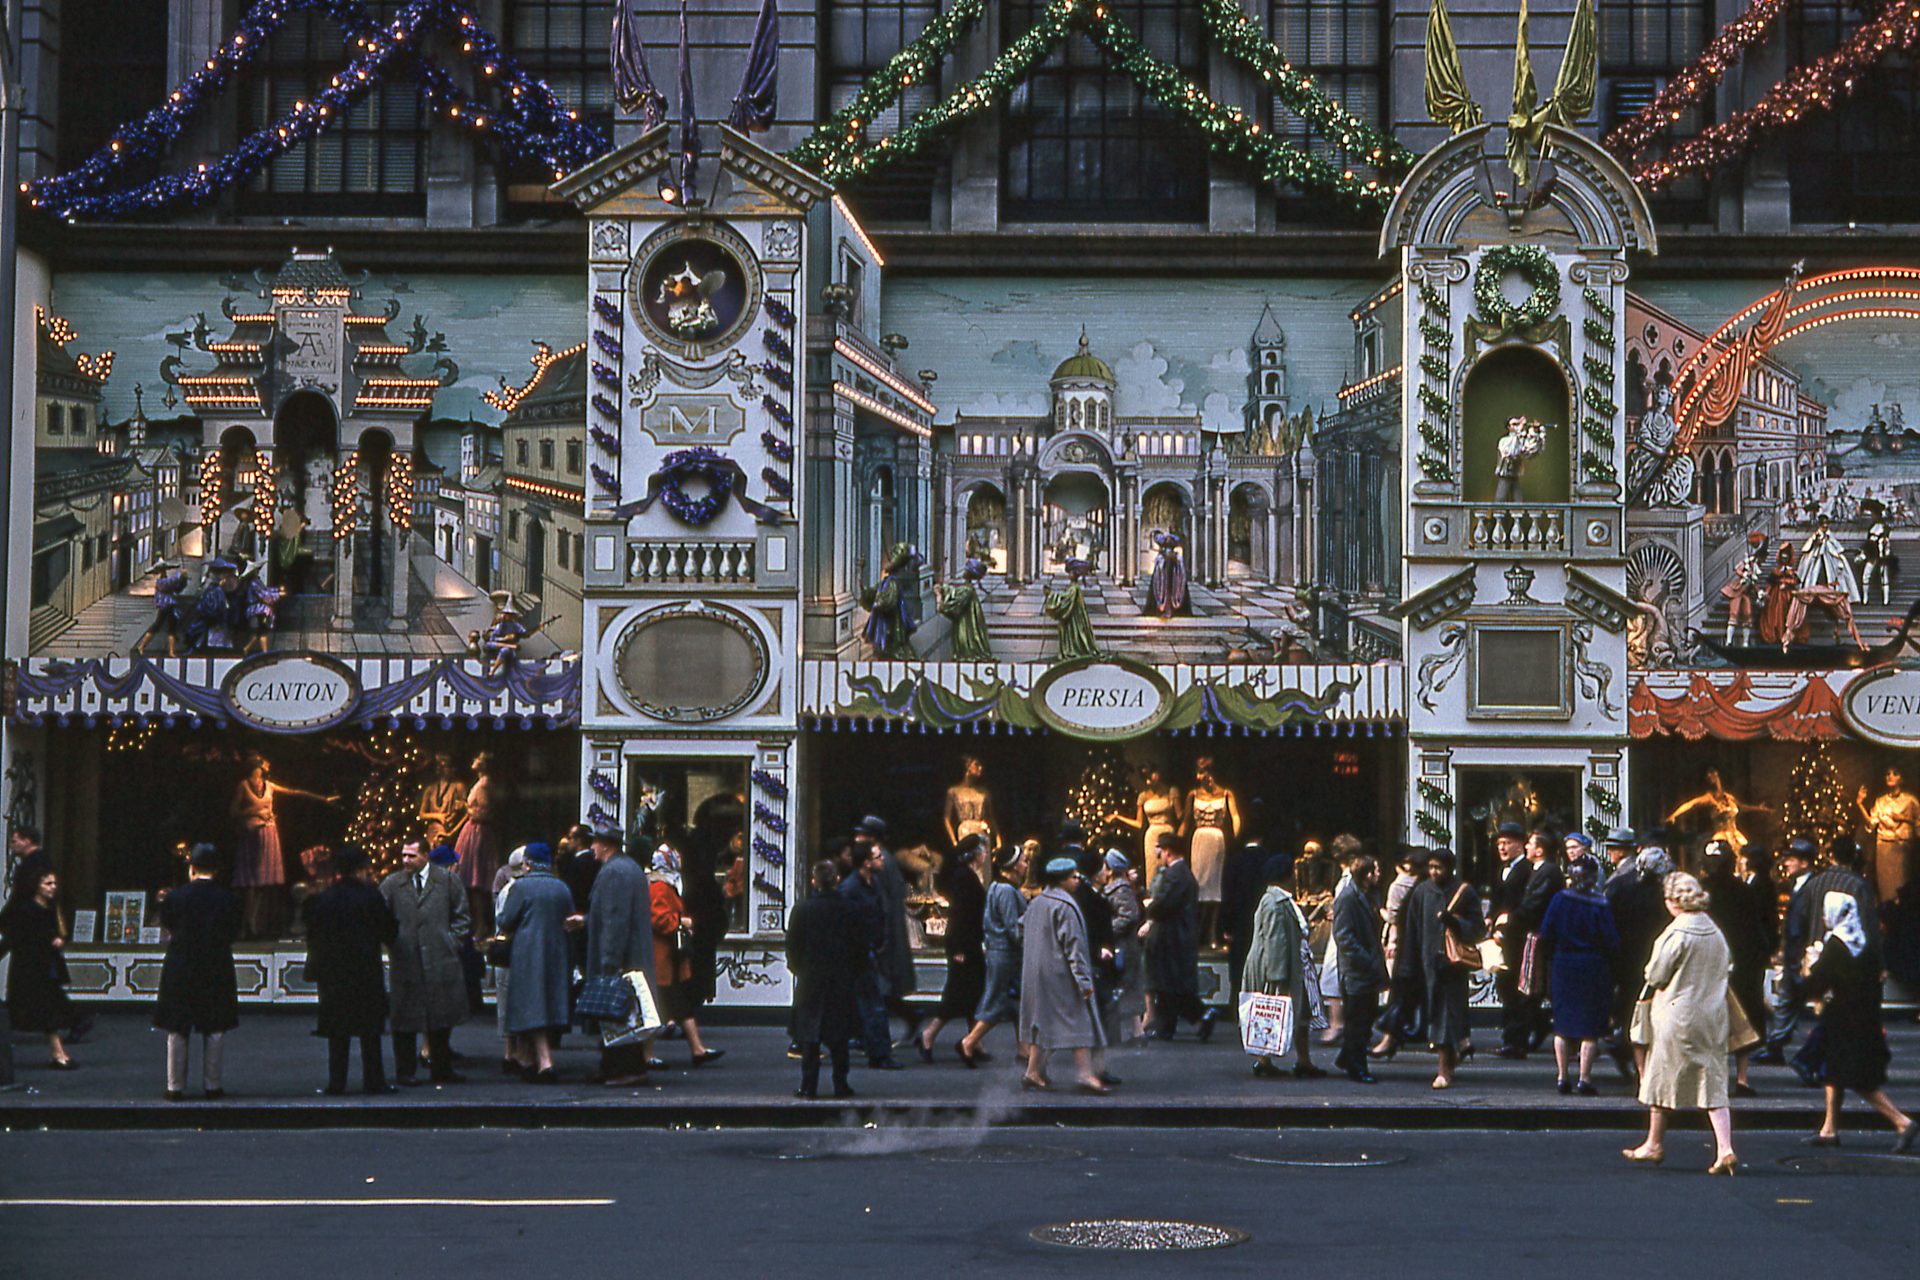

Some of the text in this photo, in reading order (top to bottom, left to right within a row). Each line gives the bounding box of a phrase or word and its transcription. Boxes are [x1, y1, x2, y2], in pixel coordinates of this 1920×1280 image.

[666, 404, 720, 435] M
[247, 682, 338, 701] CANTON
[1062, 688, 1144, 708] PERSIA
[1255, 1010, 1280, 1020] PAINTS
